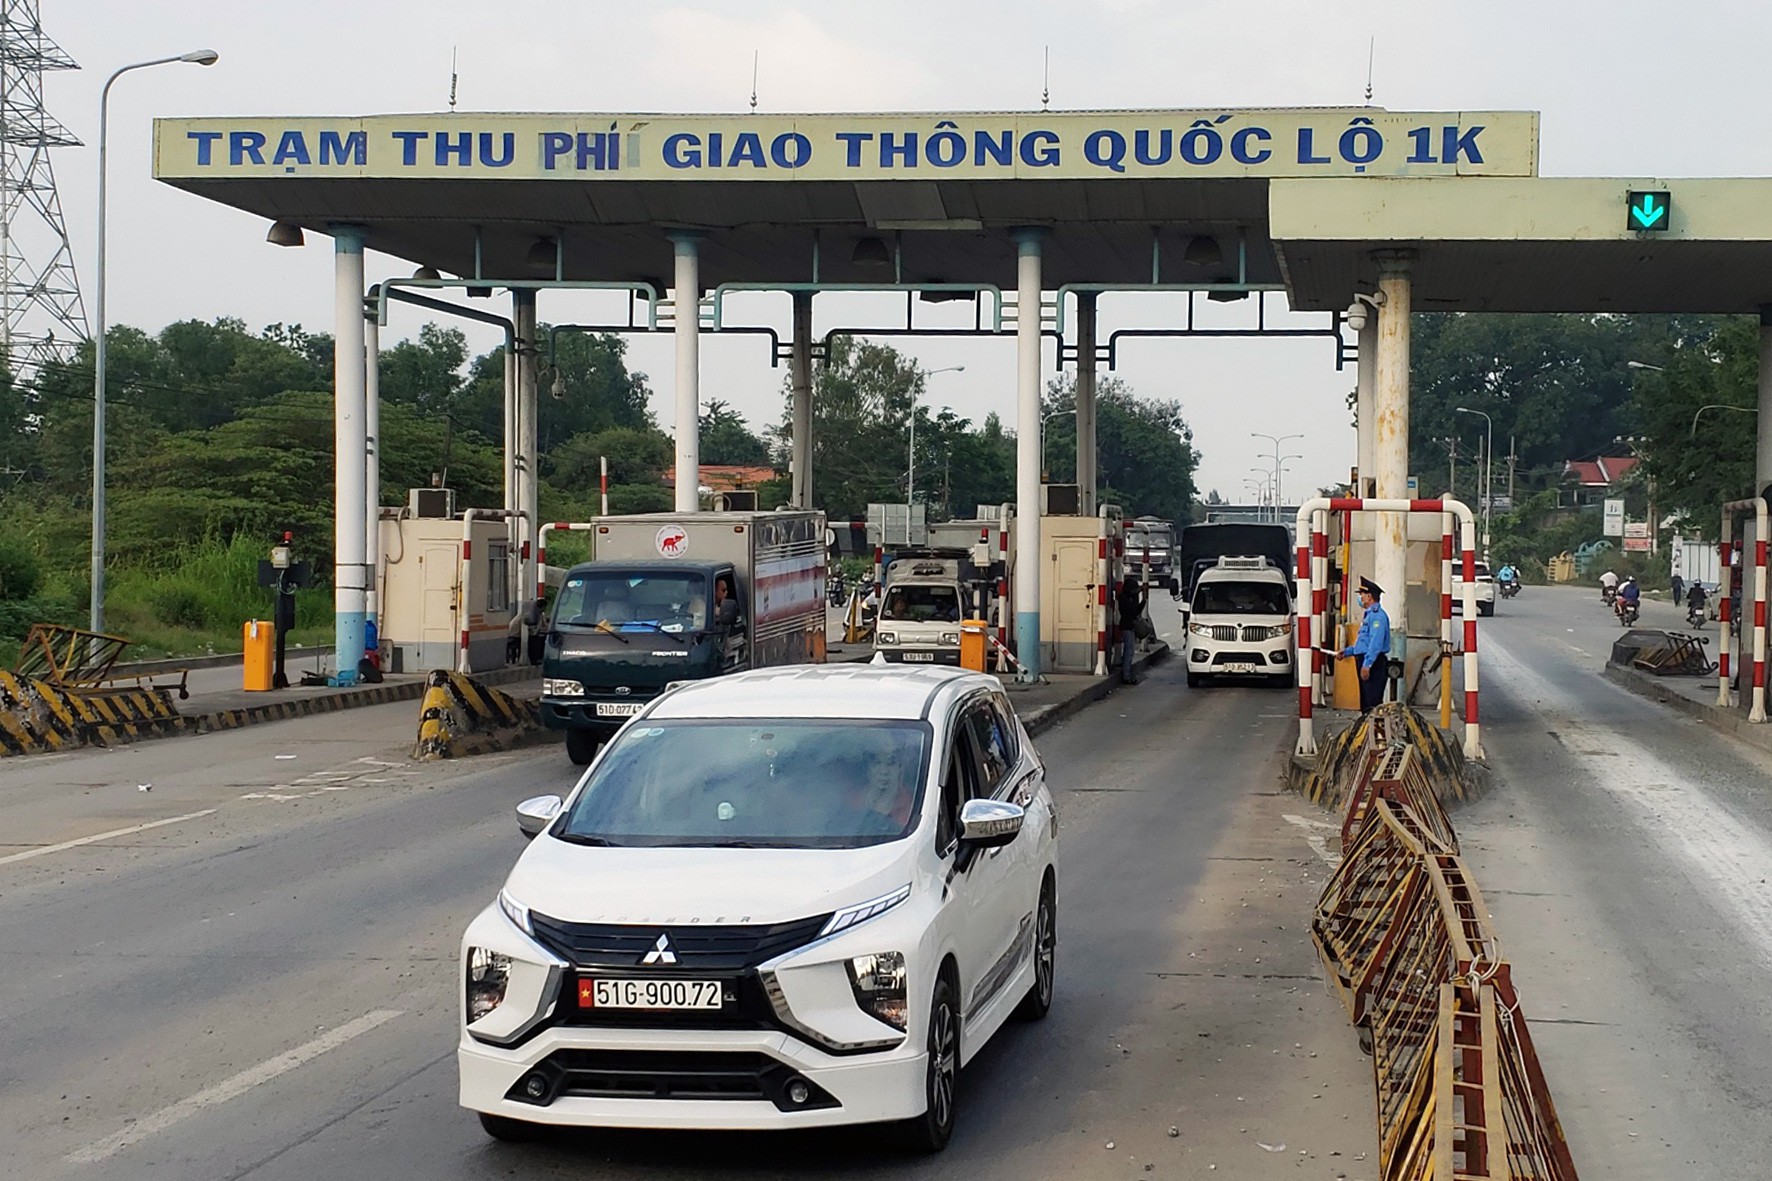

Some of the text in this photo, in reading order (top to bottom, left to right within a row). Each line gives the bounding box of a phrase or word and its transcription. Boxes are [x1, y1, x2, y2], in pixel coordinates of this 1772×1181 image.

[187, 115, 1484, 173] TRẠM THU PHÍ GIAO THÔNG QUỐC LỘ 1K
[597, 981, 719, 1007] 51G-900.72
